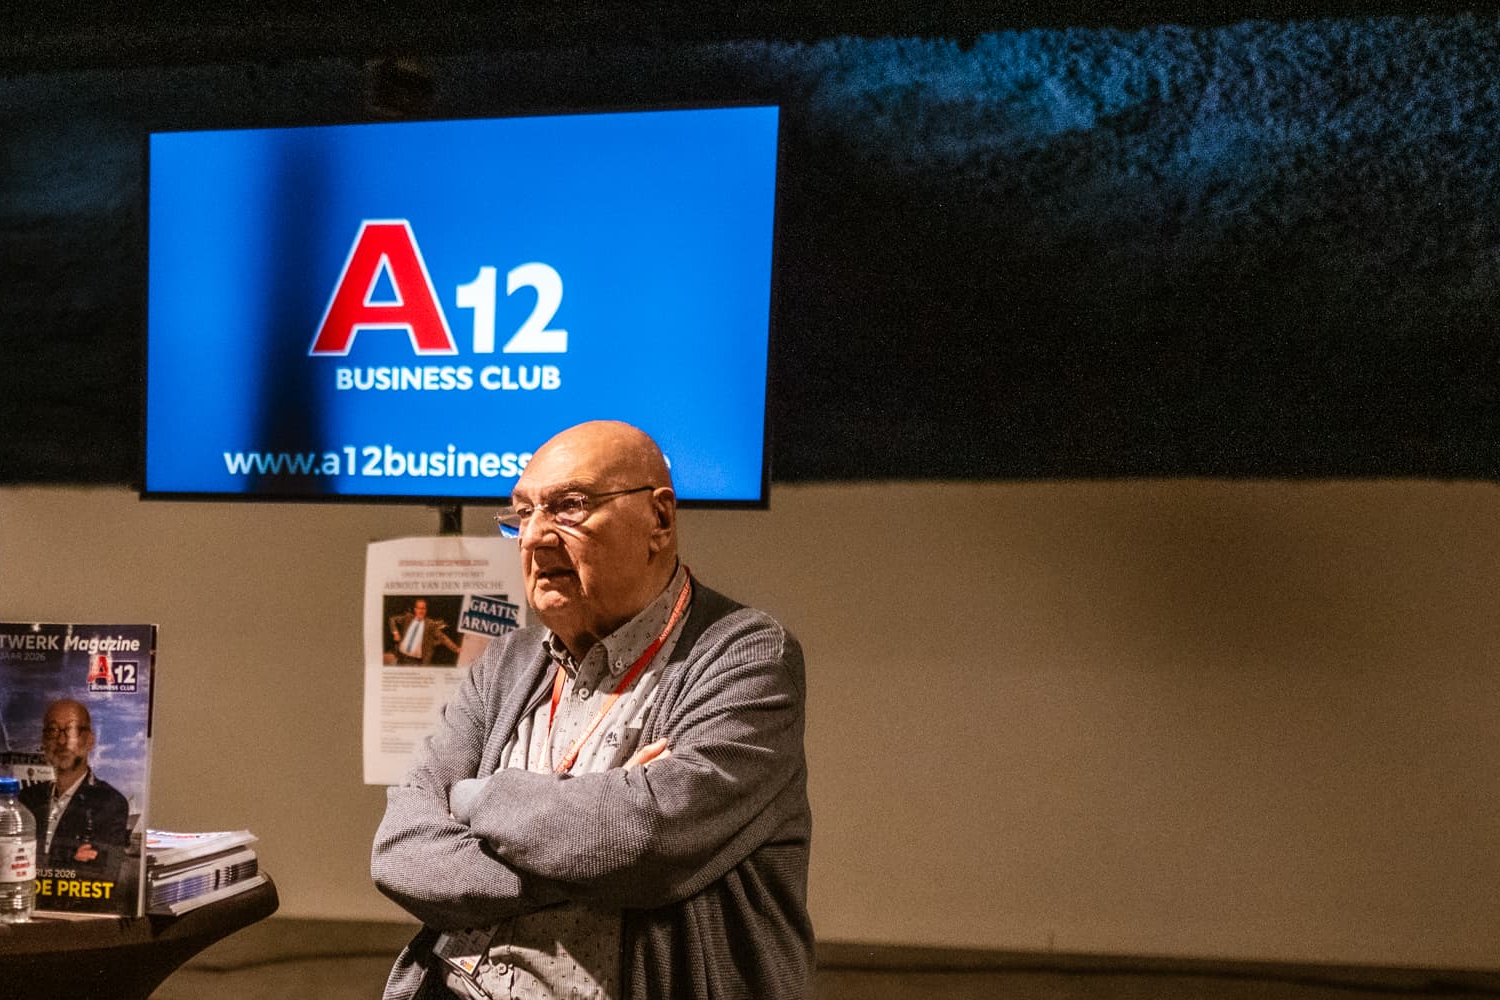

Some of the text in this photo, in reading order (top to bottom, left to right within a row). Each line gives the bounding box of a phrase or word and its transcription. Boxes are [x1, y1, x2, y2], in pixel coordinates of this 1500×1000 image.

[308, 219, 568, 356] A12
[336, 365, 561, 391] BUSINESS CLUB
[224, 445, 533, 477] www.a12business
[469, 599, 519, 621] GRATIS
[64, 635, 140, 654] Magazine
[87, 655, 136, 684] A12
[58, 880, 114, 899] PREST
